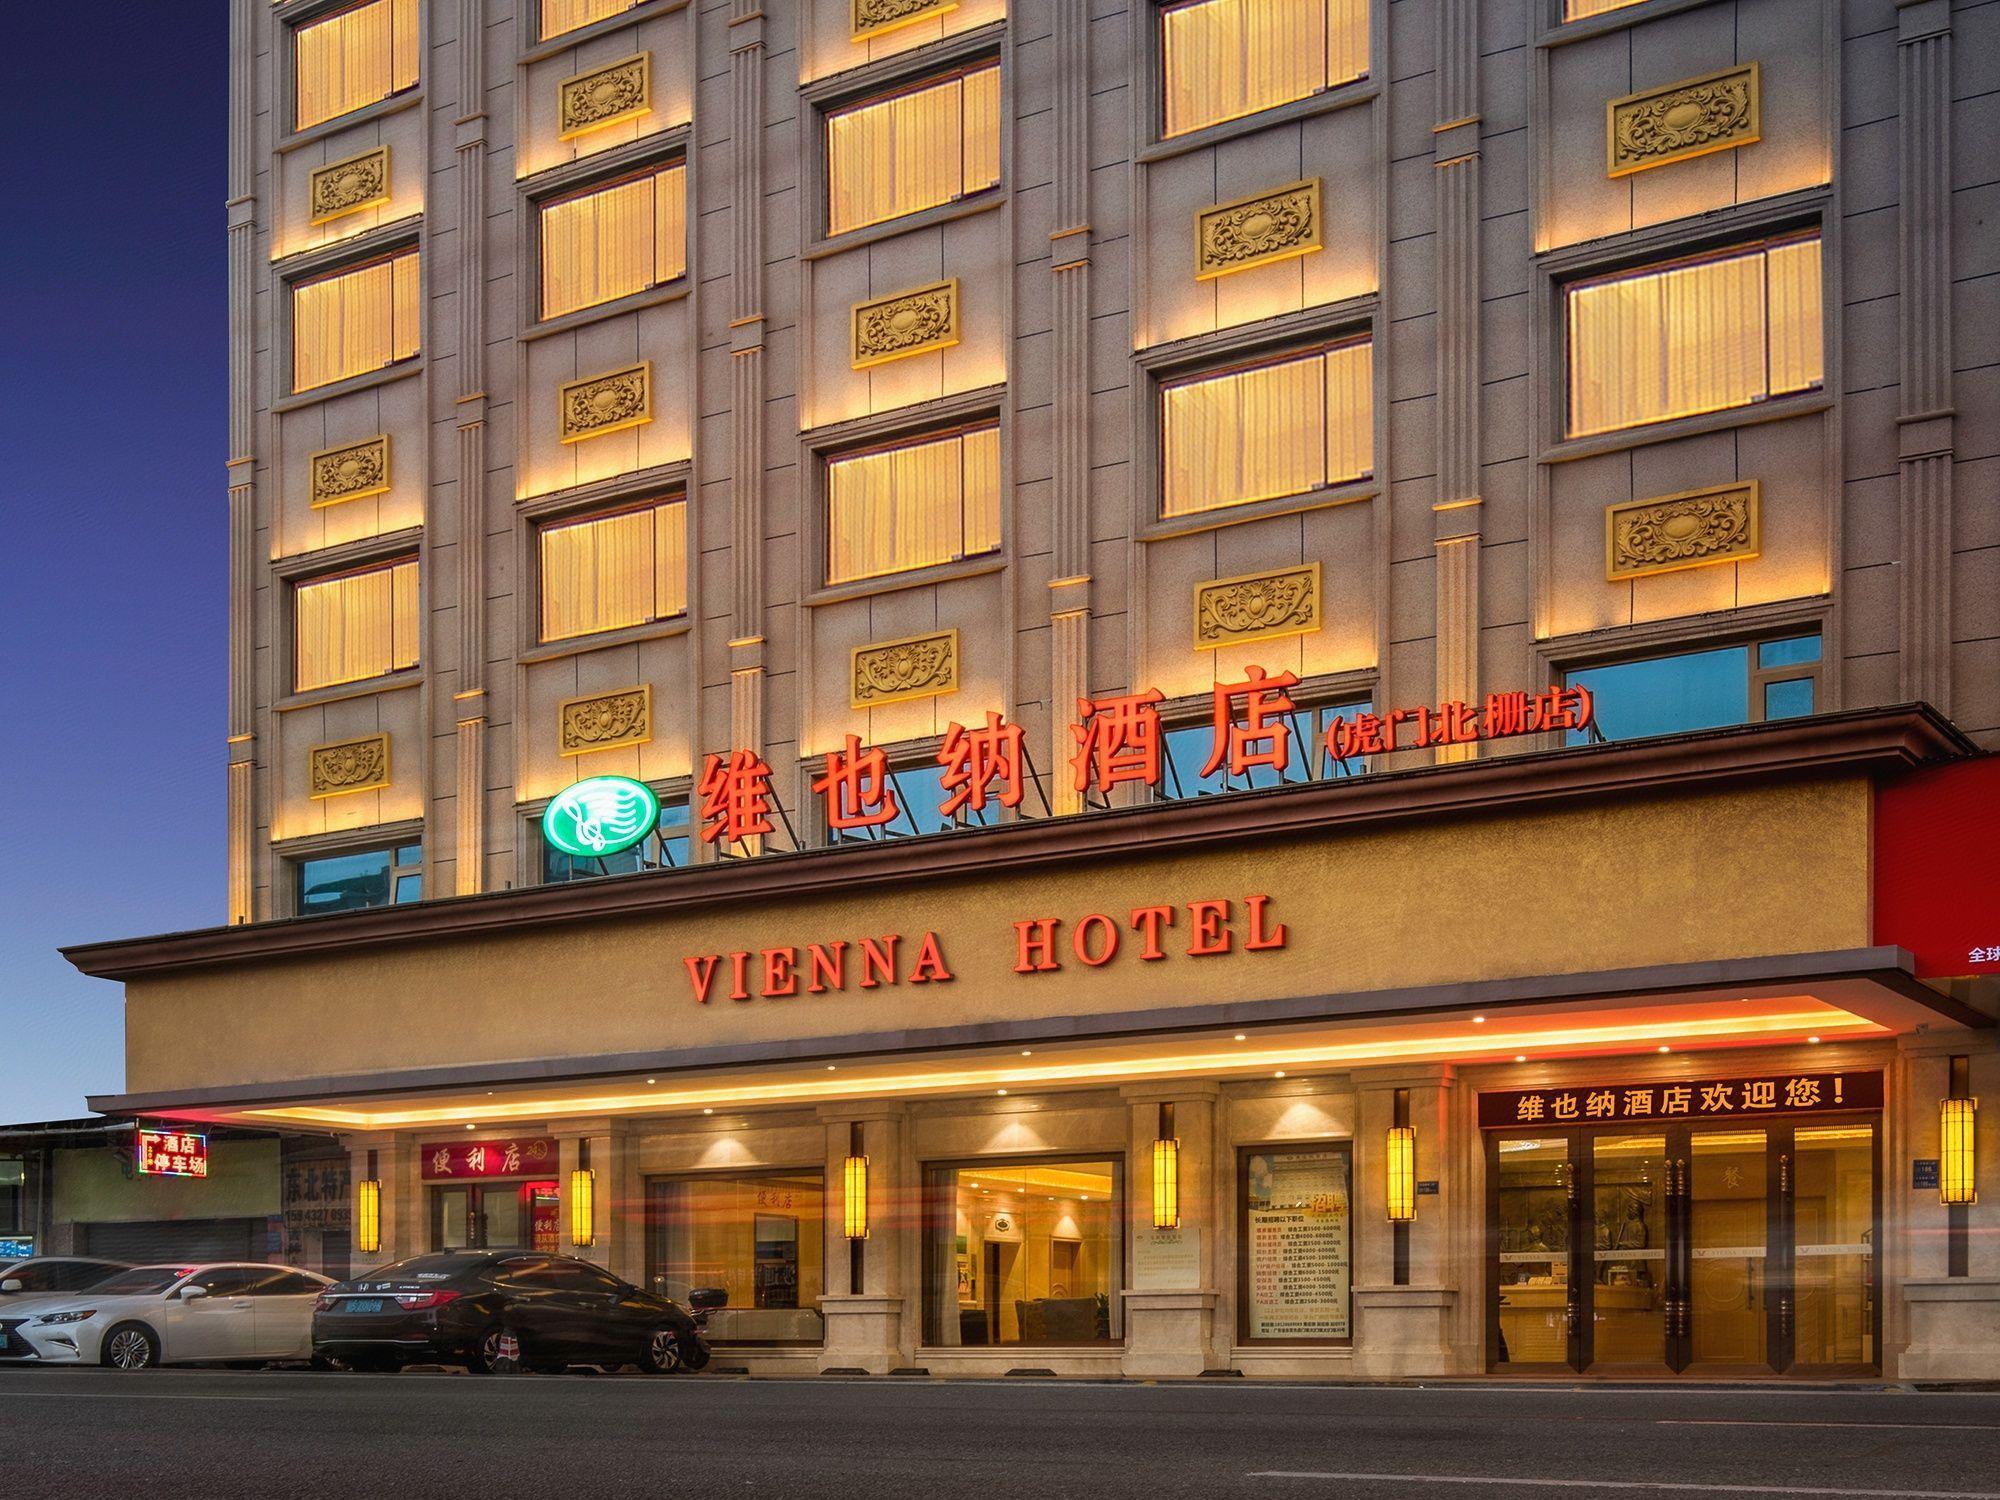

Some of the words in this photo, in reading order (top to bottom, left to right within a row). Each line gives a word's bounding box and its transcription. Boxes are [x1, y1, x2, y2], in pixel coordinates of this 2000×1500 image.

[698, 665, 1301, 843] 维也纳酒店
[1326, 683, 1593, 761] (虎门北栅店)
[684, 932, 954, 1003] VIENNA
[1014, 895, 1287, 973] HOTEL
[163, 1135, 195, 1154] 酒店
[432, 1142, 521, 1174] 便利店
[154, 1153, 204, 1174] 停车场
